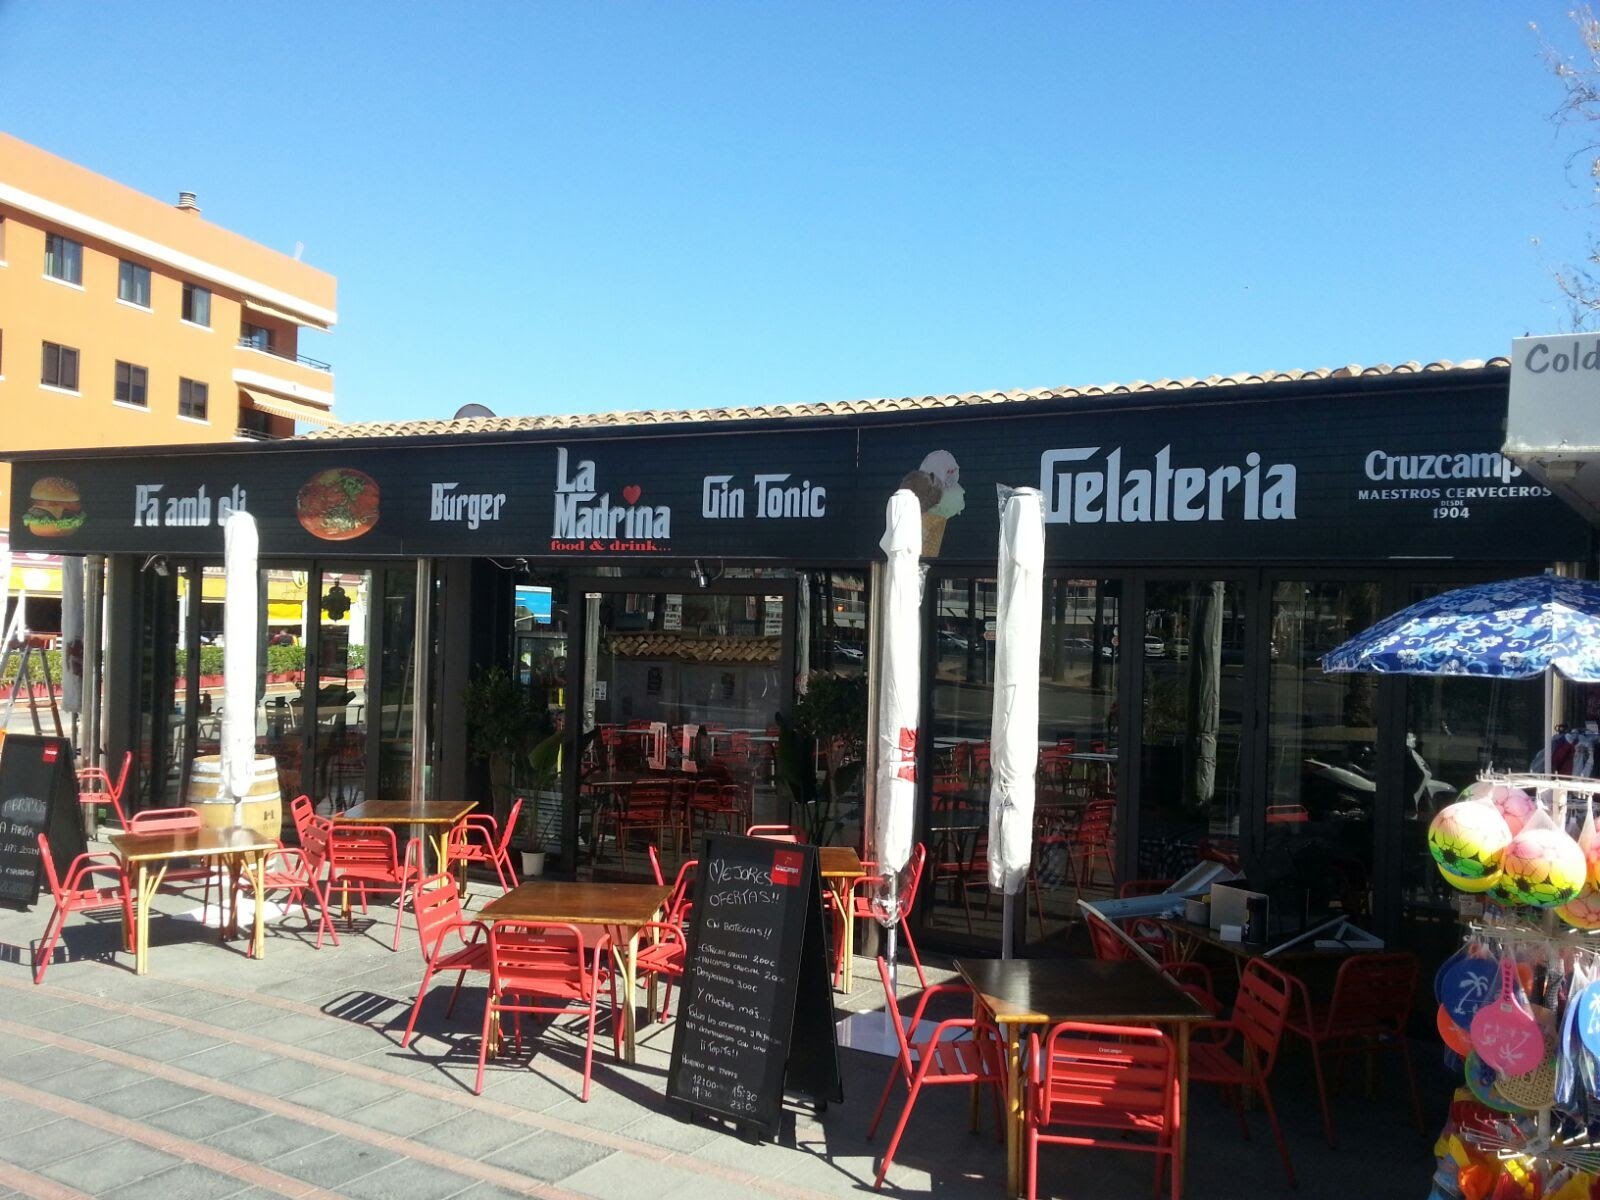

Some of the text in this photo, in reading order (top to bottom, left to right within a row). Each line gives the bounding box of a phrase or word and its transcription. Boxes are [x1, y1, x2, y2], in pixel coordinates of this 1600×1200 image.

[1525, 339, 1600, 373] Cold
[554, 447, 595, 492] La
[1040, 444, 1297, 526] Gelateria
[1364, 450, 1522, 484] Cruzcamp
[133, 484, 164, 527] Pa
[165, 484, 211, 527] amb
[429, 482, 506, 530] Burger
[702, 473, 826, 519] Gin Tonic
[1358, 486, 1552, 500] MAESTROS CERVECEROS
[1433, 506, 1470, 519] 1904
[551, 492, 671, 539] Madrina
[551, 540, 585, 551] food
[589, 540, 606, 551] &
